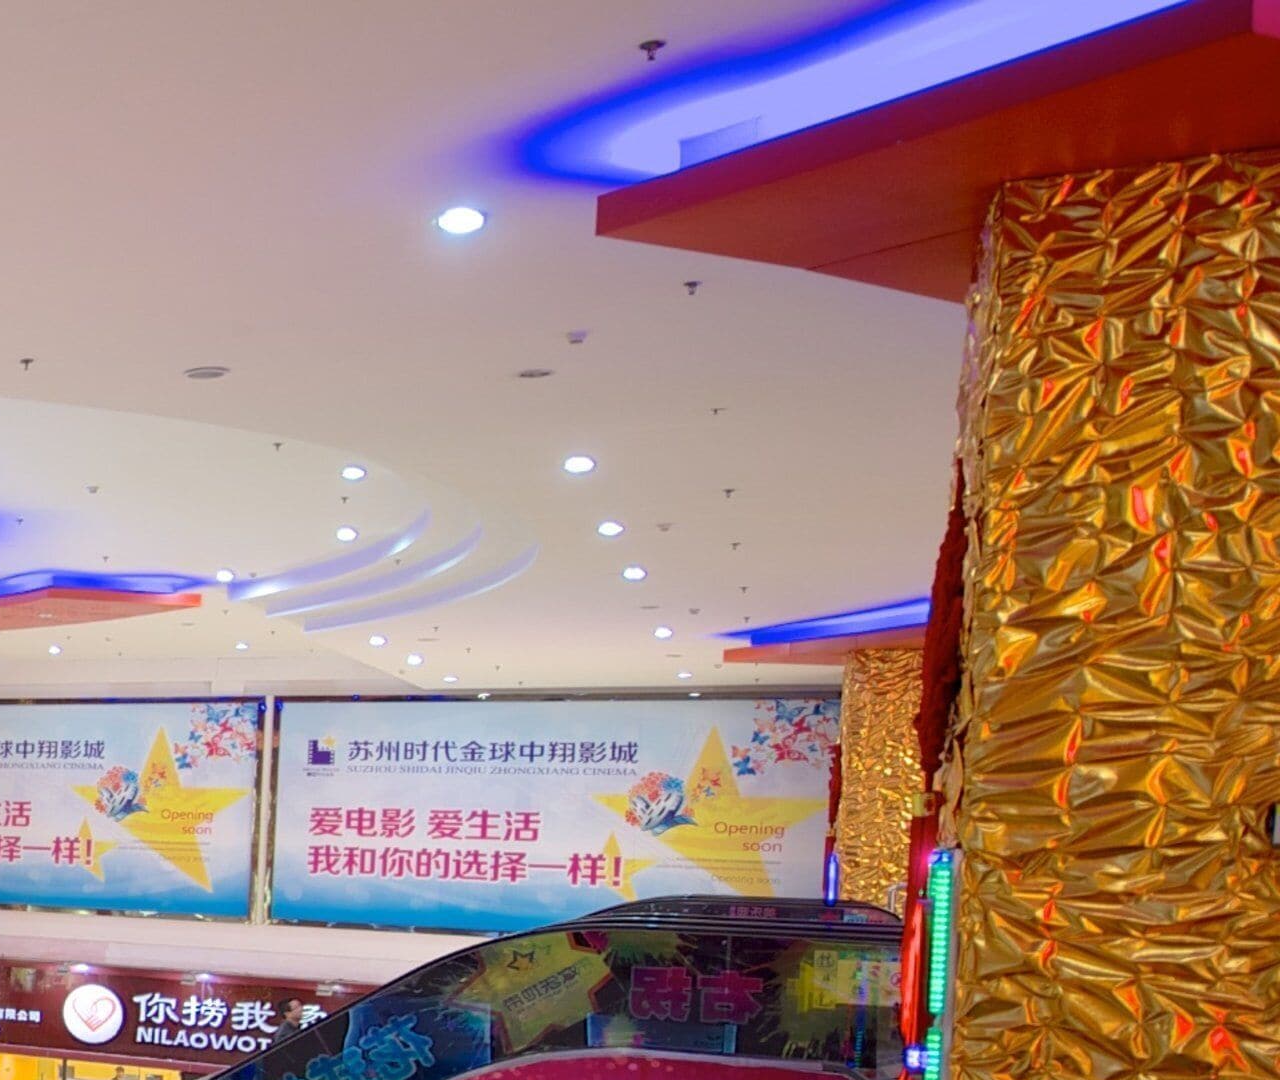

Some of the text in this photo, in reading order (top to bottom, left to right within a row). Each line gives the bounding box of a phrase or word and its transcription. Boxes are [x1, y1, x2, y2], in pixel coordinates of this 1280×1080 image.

[348, 739, 639, 764] 苏州时代金球中翔影城
[64, 763, 105, 771] CINEMA
[346, 764, 397, 774] SUZHOU
[399, 765, 442, 774] SHIDAI
[444, 765, 487, 775] JINQIU
[490, 766, 580, 776] ZHONGXIANG
[583, 766, 638, 776] CINEMA
[160, 808, 214, 822] Opening
[181, 825, 213, 835] soon
[307, 806, 542, 842] 爱电影 爱生活
[714, 821, 785, 839] Opening
[742, 841, 782, 852] soon
[306, 844, 624, 888] 我和你的选择一样!
